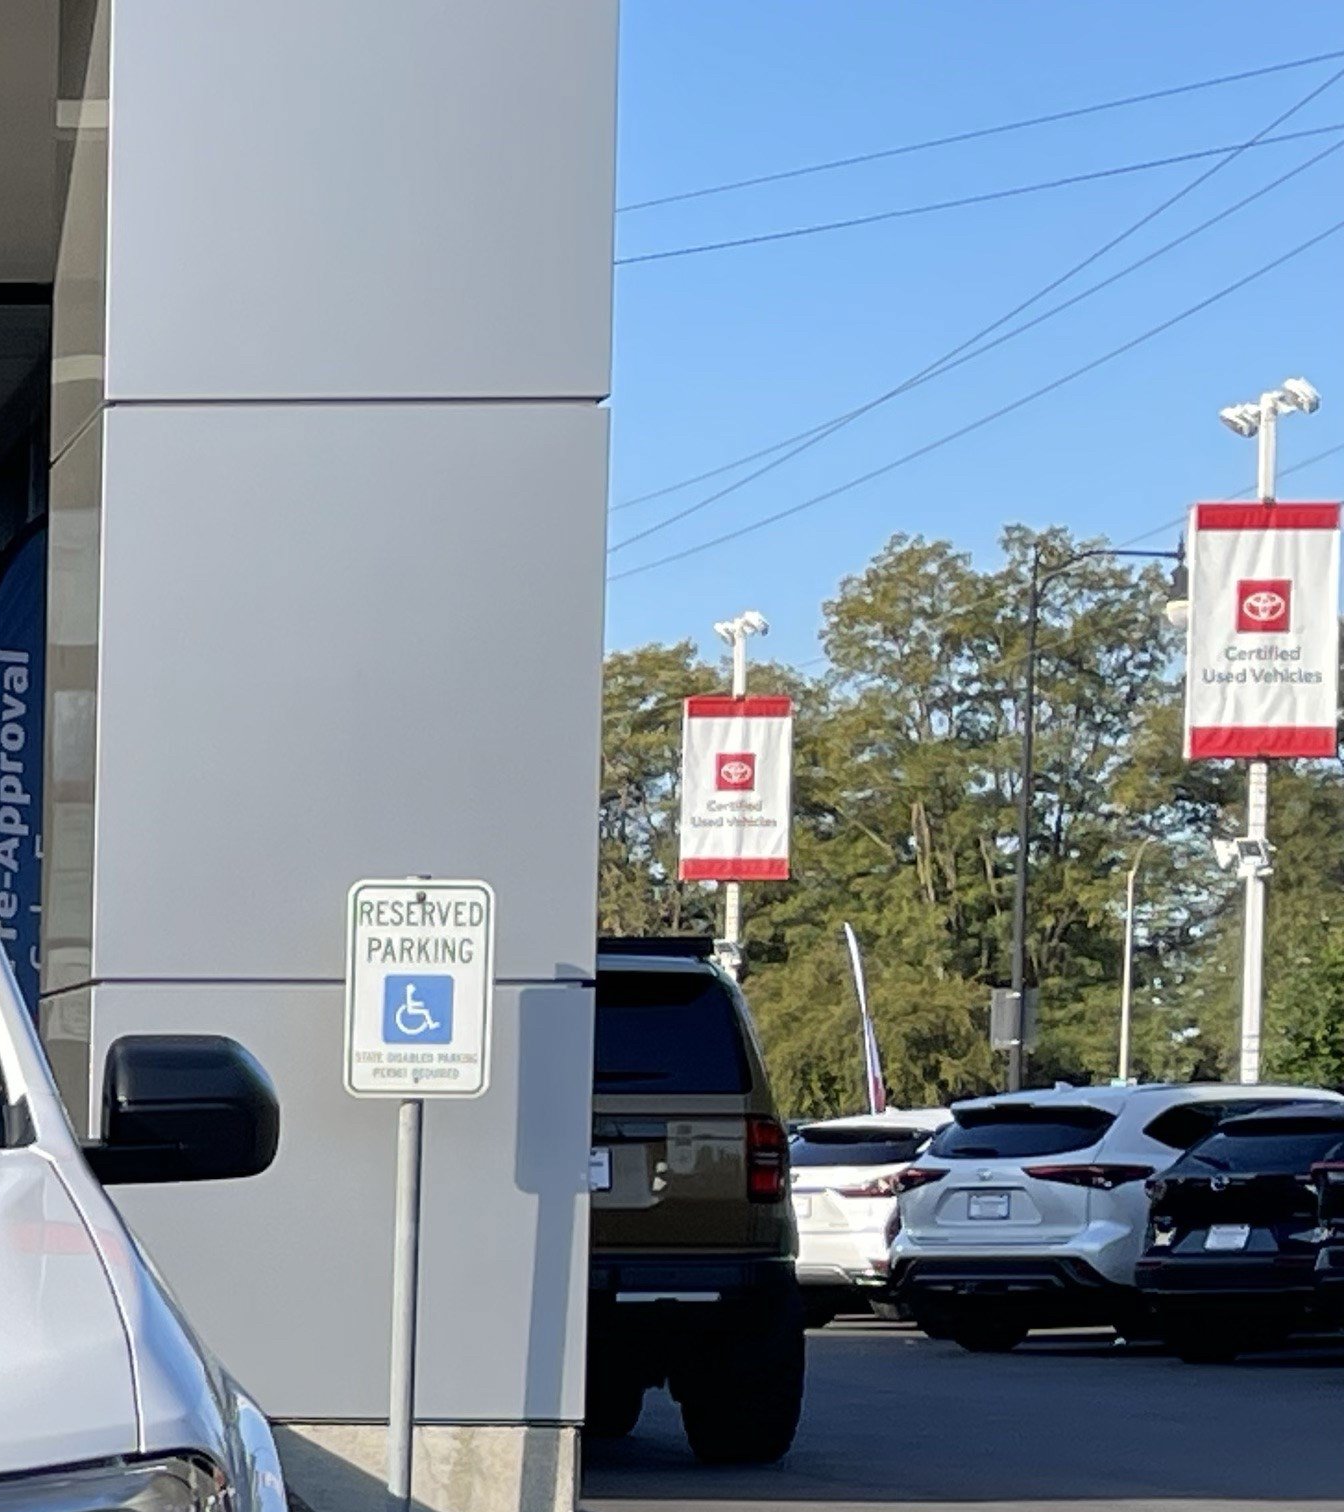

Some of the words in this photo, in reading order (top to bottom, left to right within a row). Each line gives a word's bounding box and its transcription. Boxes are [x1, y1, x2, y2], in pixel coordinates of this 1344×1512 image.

[1225, 645, 1302, 661] Certified
[1202, 668, 1247, 683] Used
[1249, 667, 1323, 683] Vehicles
[359, 901, 483, 927] RESERVED
[367, 937, 474, 964] PARKING
